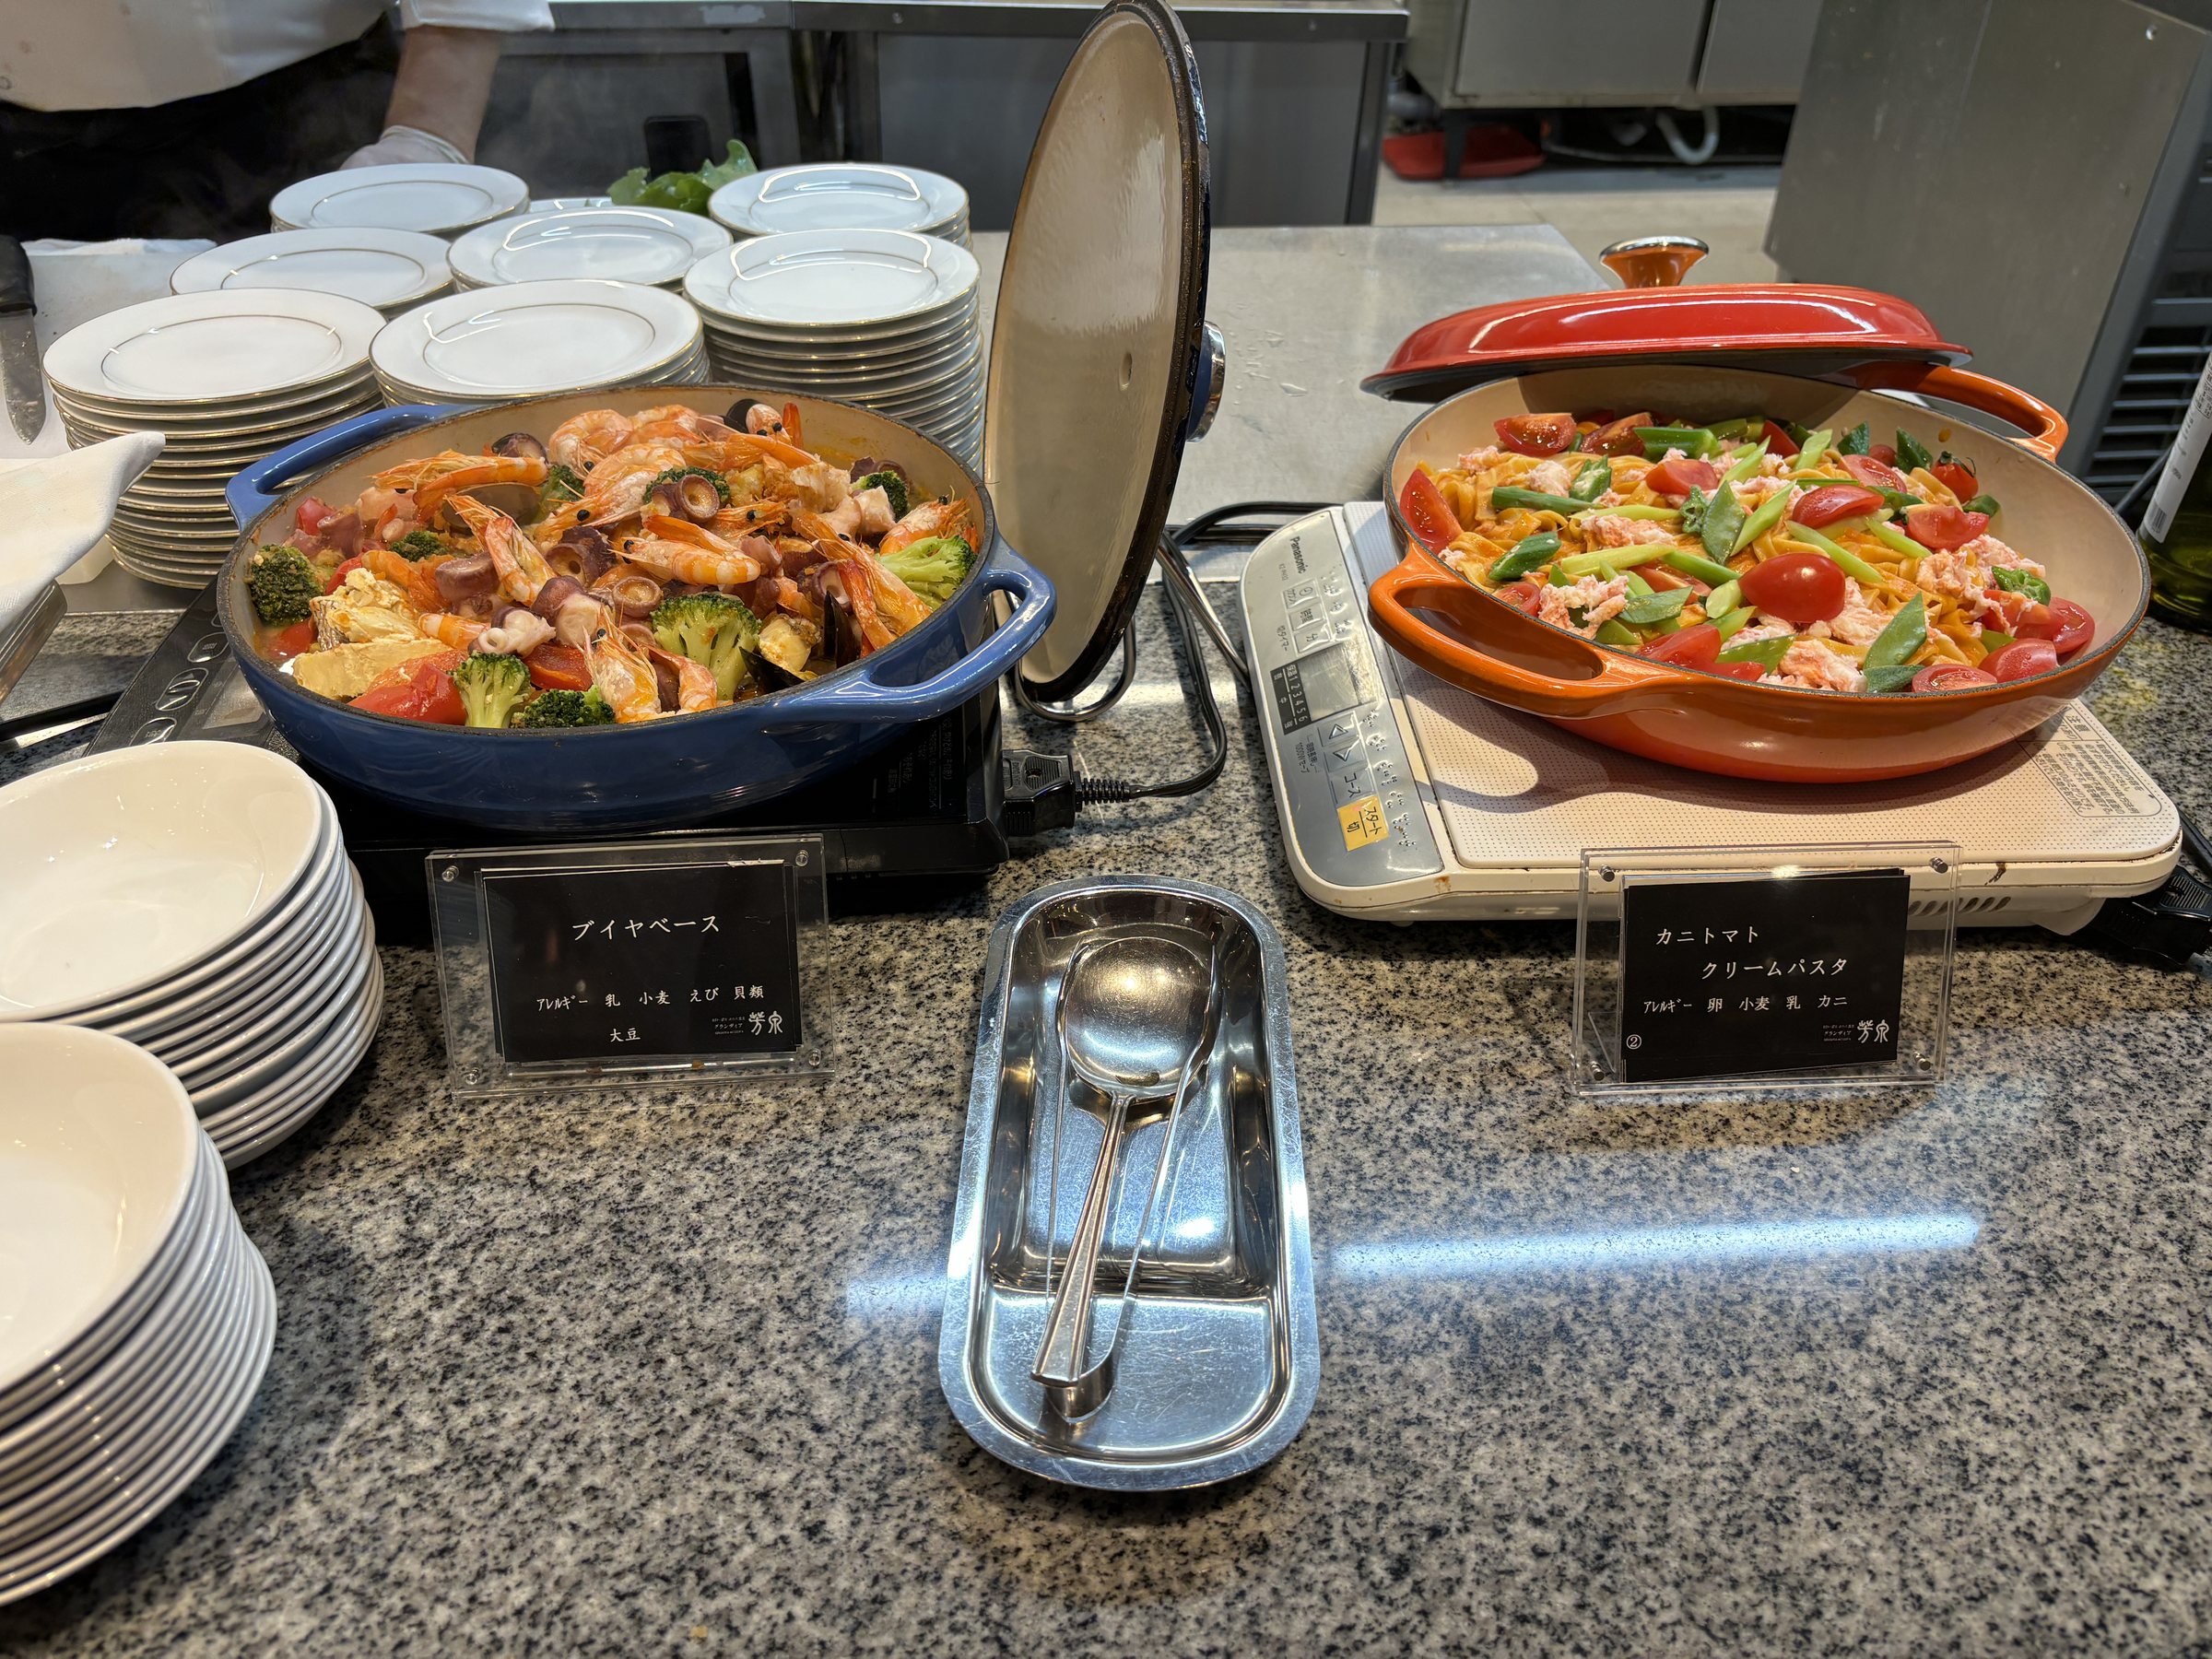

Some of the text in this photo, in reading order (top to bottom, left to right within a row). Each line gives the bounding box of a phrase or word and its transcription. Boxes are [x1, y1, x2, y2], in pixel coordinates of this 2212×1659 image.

[1290, 536, 1308, 574] Panasonic
[1306, 633, 1318, 642] 分
[2065, 715, 2090, 731] 注意
[1345, 772, 1360, 798] コース
[1347, 821, 1359, 832] 切
[1363, 806, 1382, 835] スタート
[571, 915, 720, 941] ブイヤベース
[1656, 926, 1759, 945] カニトマト
[1701, 958, 1848, 980] クリームパスタ
[605, 994, 621, 1007] 乳
[639, 990, 671, 1006] 小麦
[689, 986, 720, 1003] えび
[734, 984, 764, 999] 貝類
[1707, 997, 1724, 1013] 卵
[1738, 995, 1771, 1011] 小麦
[1785, 995, 1801, 1009] 乳
[1817, 994, 1848, 1009] カニ
[609, 1027, 641, 1043] 大豆
